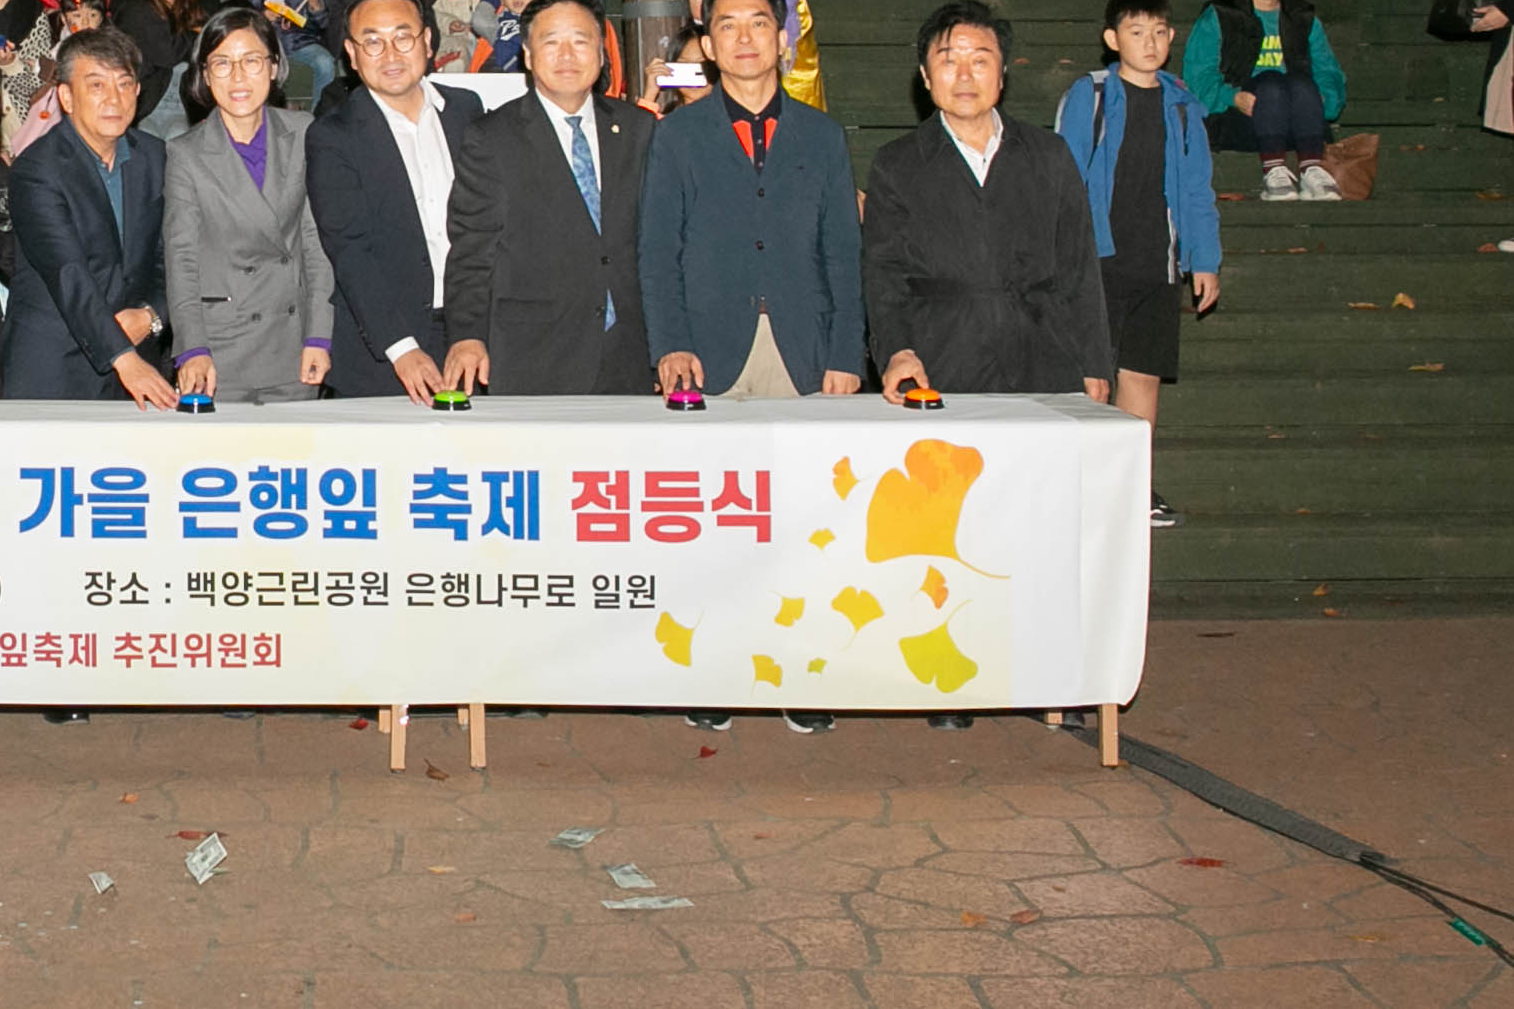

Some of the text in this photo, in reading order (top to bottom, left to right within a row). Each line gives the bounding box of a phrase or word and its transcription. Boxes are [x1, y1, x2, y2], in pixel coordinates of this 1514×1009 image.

[19, 466, 150, 539] 가을
[178, 466, 378, 540] 은행잎
[409, 467, 540, 541] 축제
[571, 470, 772, 543] 점등식
[84, 571, 150, 607] 장소
[187, 571, 389, 607] 백양근린공원
[405, 572, 577, 608] 은행나무로
[592, 574, 656, 609] 일원
[113, 632, 282, 669] 추진위원회
